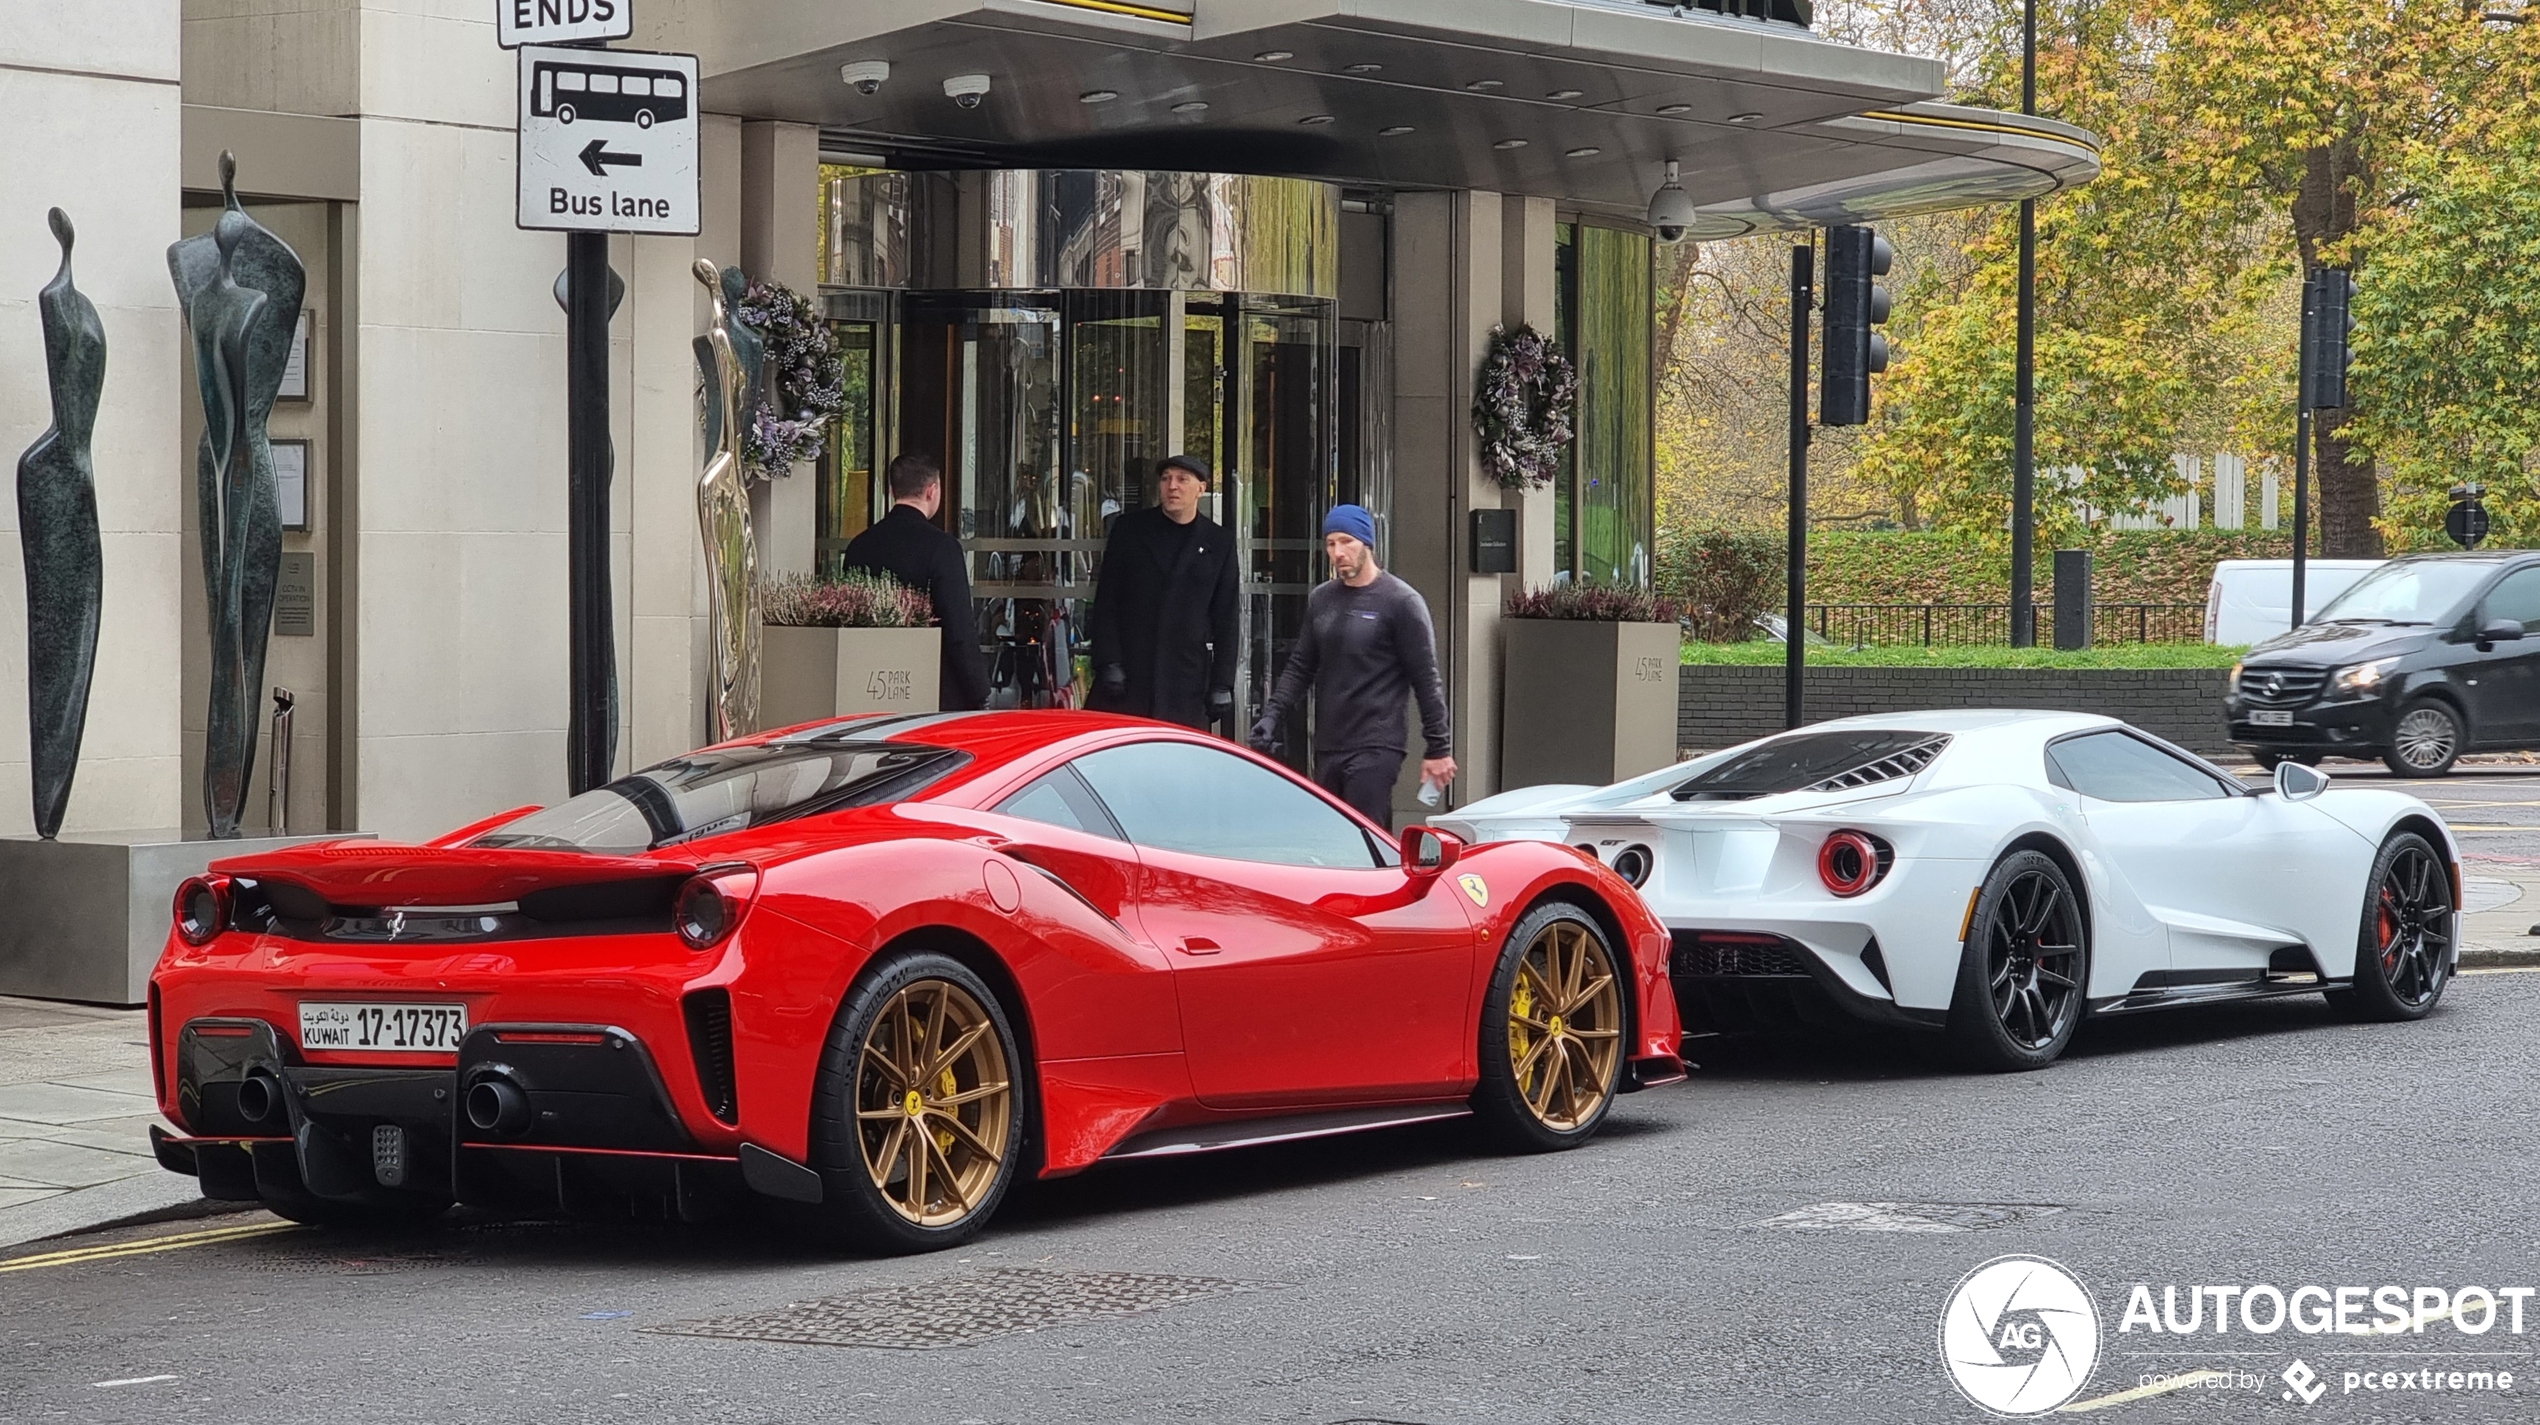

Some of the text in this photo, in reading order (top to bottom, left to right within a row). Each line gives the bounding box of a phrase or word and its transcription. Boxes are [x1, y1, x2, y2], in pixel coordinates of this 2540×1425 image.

[514, 0, 615, 29] ENDS
[550, 187, 670, 218] Bus lane
[1635, 657, 1648, 681] 45
[866, 670, 911, 700] 45 PARK
[887, 685, 911, 700] LANE
[302, 1008, 350, 1025] دولة الكويت
[303, 1027, 350, 1045] KUWAIT
